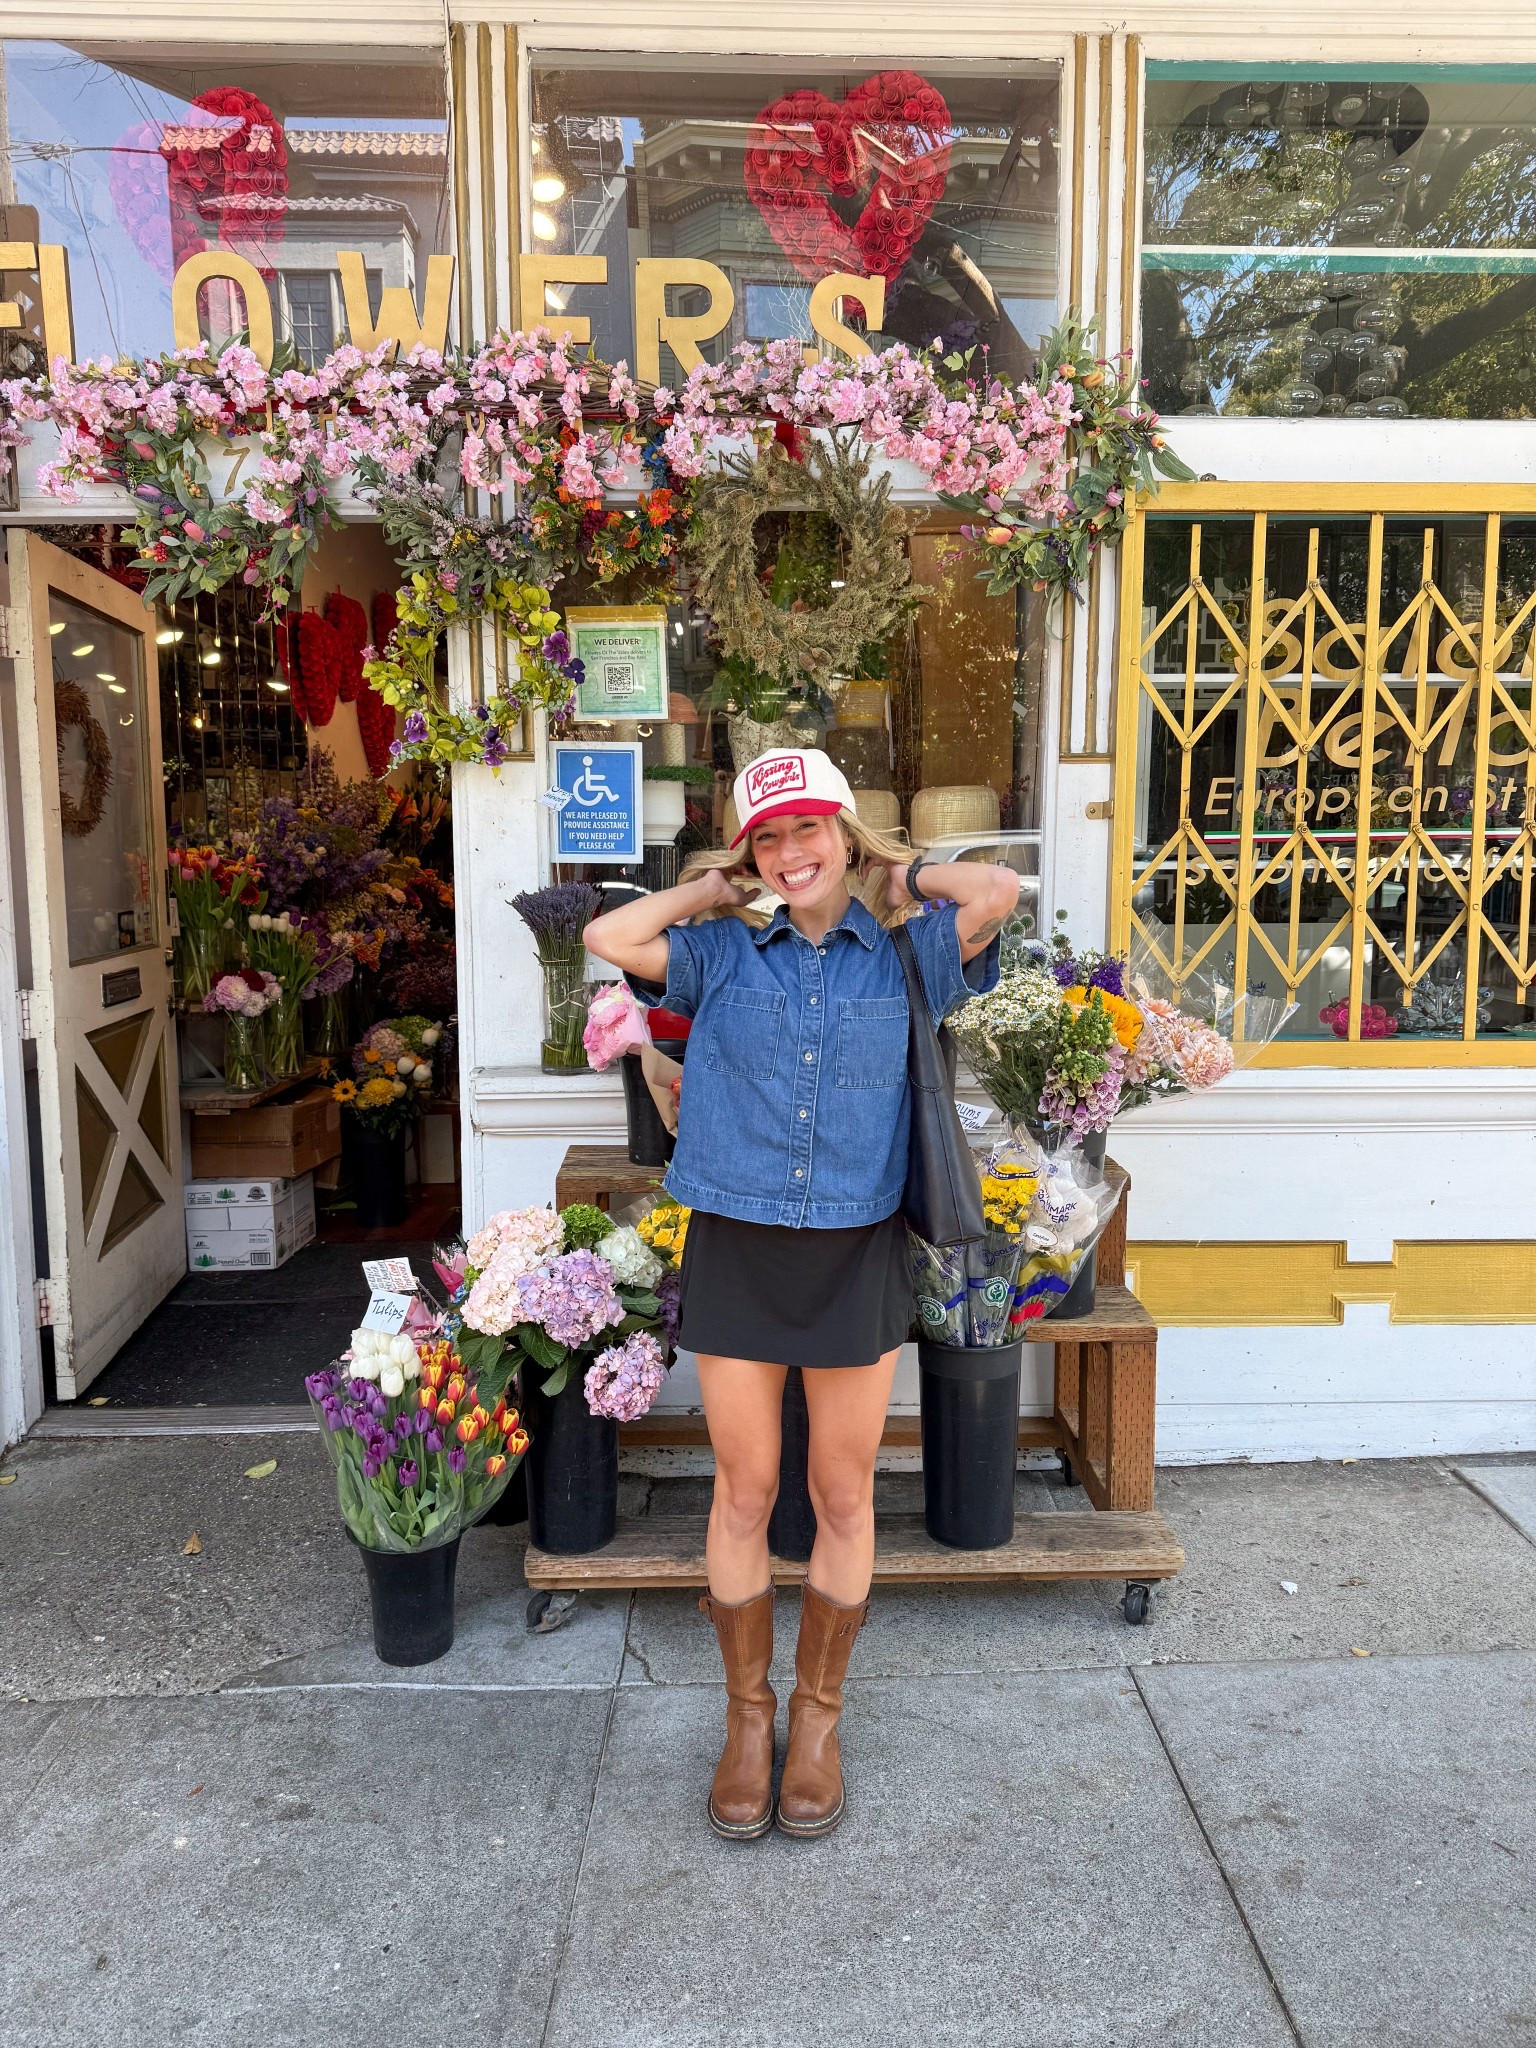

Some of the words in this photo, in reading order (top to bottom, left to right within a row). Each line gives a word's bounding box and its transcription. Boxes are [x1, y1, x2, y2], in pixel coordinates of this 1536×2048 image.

[594, 638, 607, 646] WE
[752, 761, 798, 791] Kissing
[762, 772, 800, 795] Cowgirls
[1204, 777, 1448, 821] European
[565, 811, 576, 819] WE
[590, 812, 618, 820] PLEASED
[563, 821, 592, 829] PROVIDE
[569, 832, 575, 840] IF
[576, 832, 590, 840] YOU
[590, 832, 607, 840] NEED
[608, 832, 625, 840] HELP
[578, 842, 602, 850] PLEASE
[602, 842, 616, 850] ASK
[372, 1298, 405, 1323] Tulips
